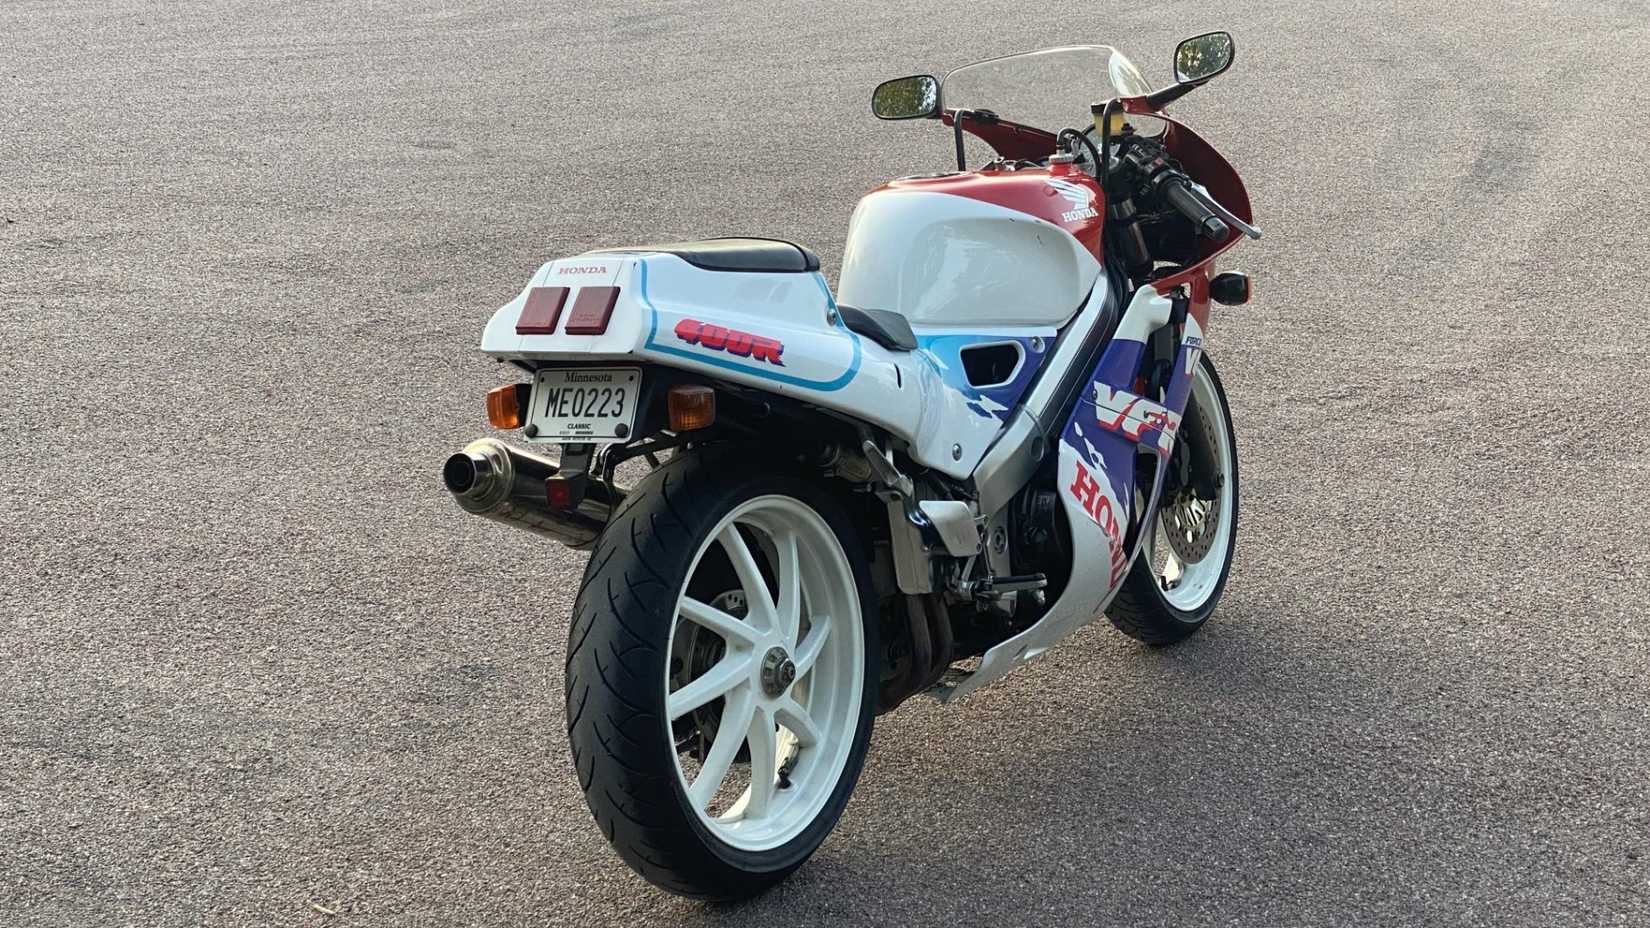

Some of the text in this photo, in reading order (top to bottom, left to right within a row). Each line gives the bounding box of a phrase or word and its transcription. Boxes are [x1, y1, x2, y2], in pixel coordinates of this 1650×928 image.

[1062, 207, 1099, 222] HONDA
[559, 266, 608, 275] HONDA
[564, 371, 613, 383] Minnesota
[544, 387, 626, 418] ME0223
